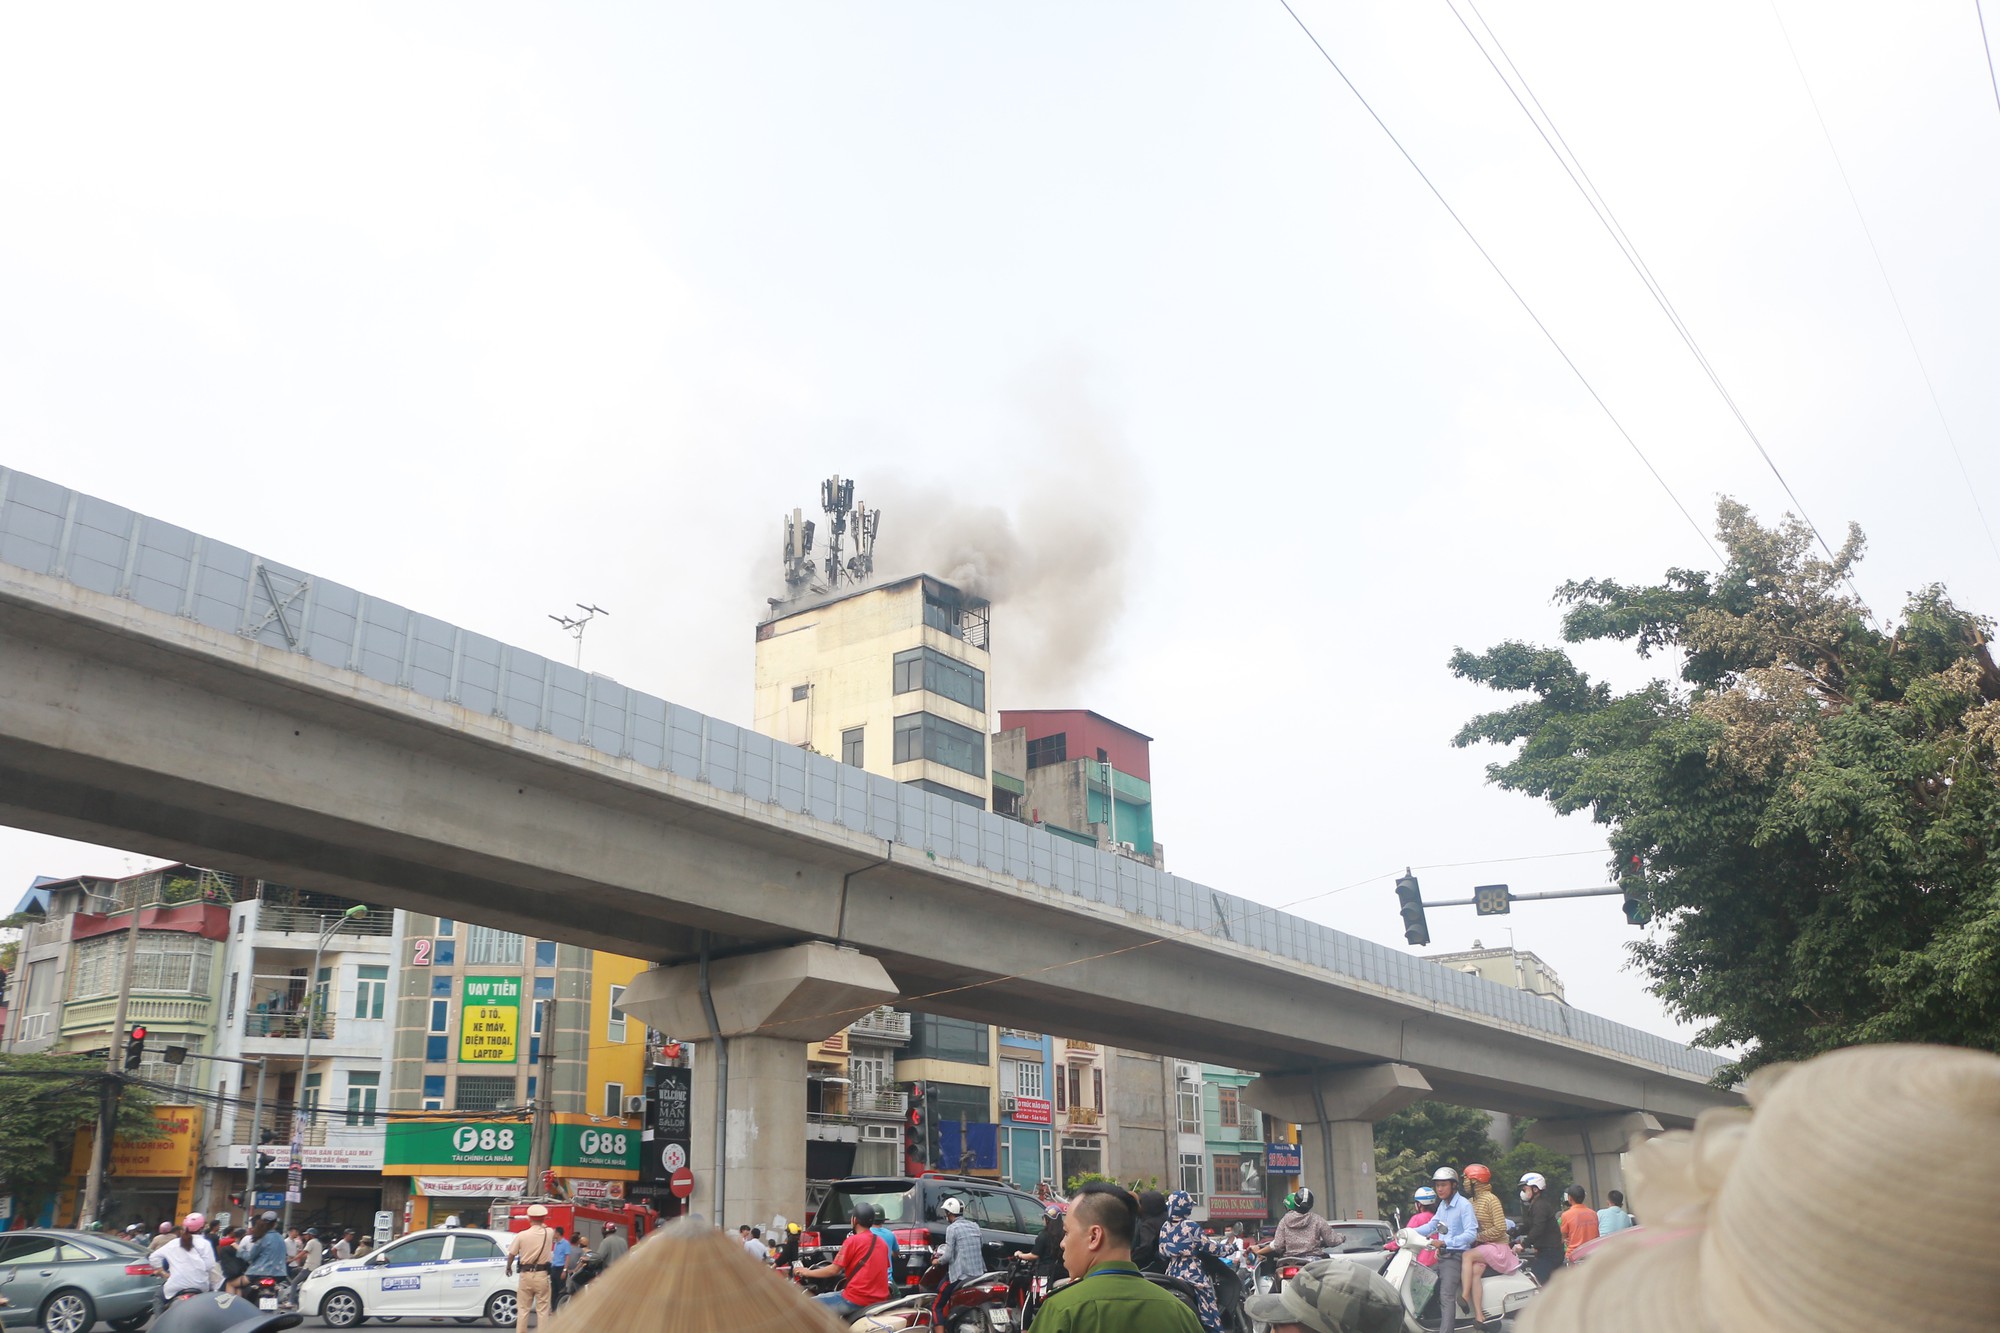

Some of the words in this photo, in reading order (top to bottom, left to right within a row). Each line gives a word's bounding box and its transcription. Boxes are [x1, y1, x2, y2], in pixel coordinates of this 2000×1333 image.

[413, 939, 431, 965] 2
[468, 983, 490, 996] VAY
[492, 979, 517, 996] TIỀN
[473, 1023, 483, 1032] XE
[473, 1049, 503, 1058] LAPTOP
[659, 1089, 687, 1101] WELCOME
[659, 1107, 685, 1118] MAN
[658, 1118, 685, 1127] SALON
